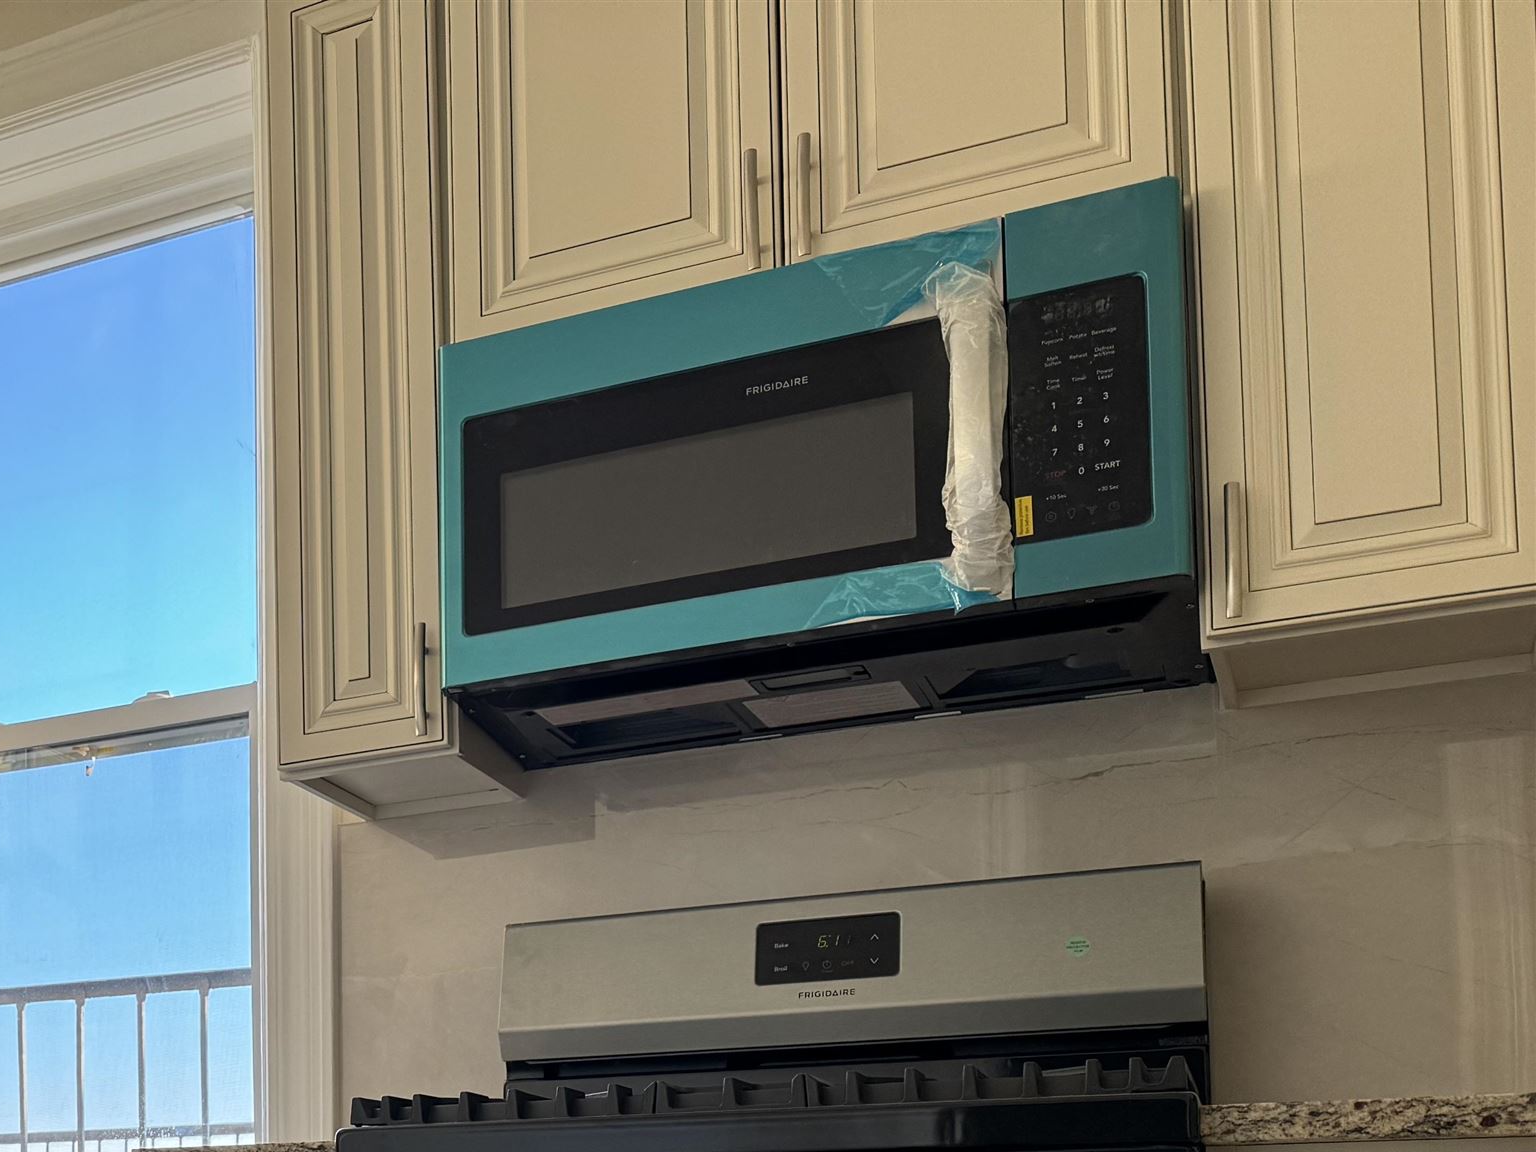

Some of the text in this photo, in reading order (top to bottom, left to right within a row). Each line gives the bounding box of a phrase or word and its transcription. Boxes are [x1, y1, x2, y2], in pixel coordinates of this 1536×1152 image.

[746, 376, 808, 396] FRIGIDAIRE
[1103, 392, 1109, 400] 3
[1051, 402, 1056, 410] 1
[1103, 415, 1109, 424] 6
[1077, 420, 1083, 428] 5
[1078, 443, 1084, 451] 8
[1104, 439, 1110, 447] 9
[1052, 448, 1058, 456] 7
[1095, 460, 1120, 471] START
[1078, 467, 1084, 475] 0
[799, 988, 855, 999] FRIGIDAIRE
